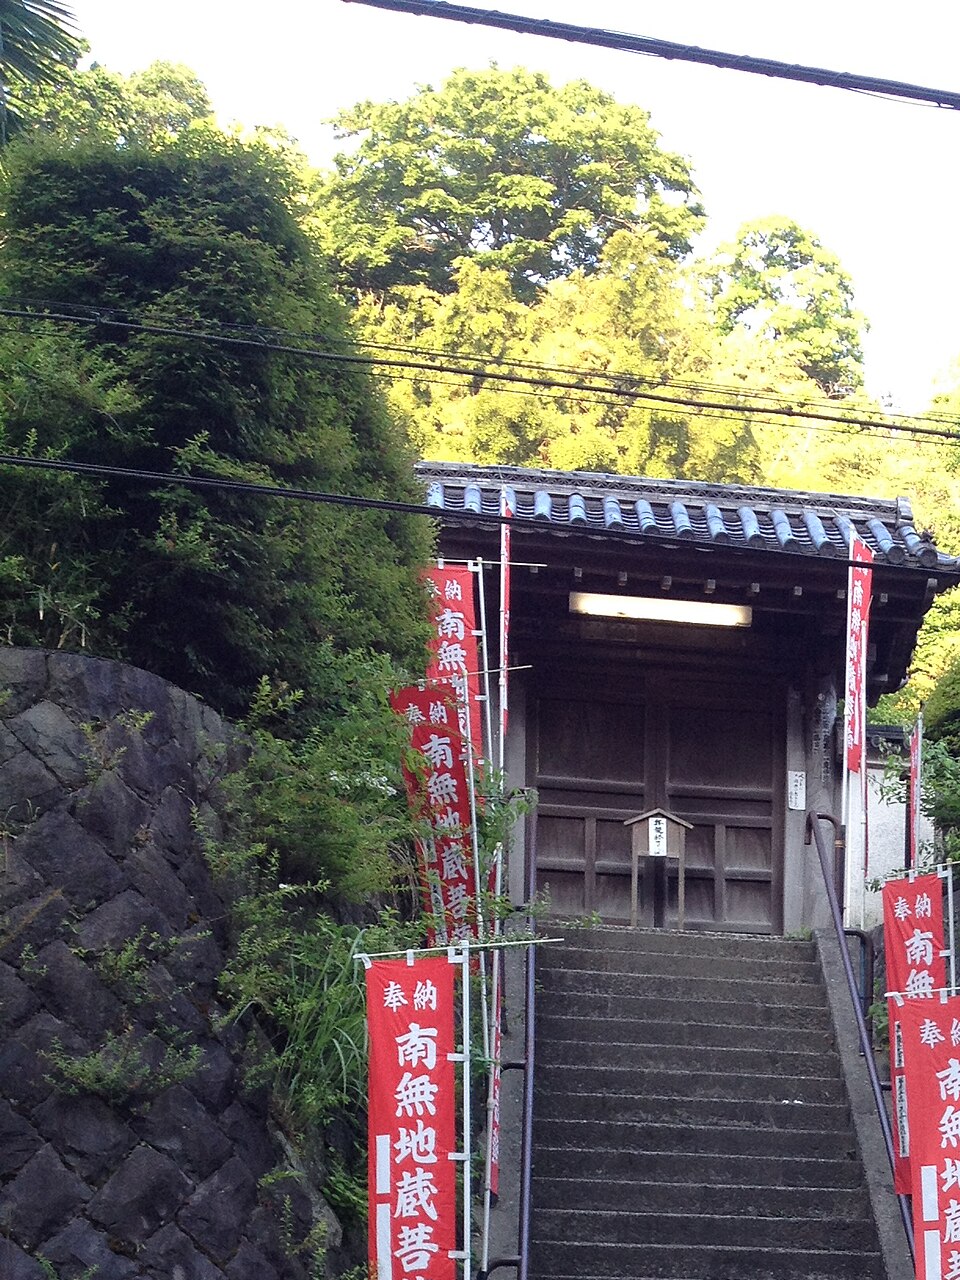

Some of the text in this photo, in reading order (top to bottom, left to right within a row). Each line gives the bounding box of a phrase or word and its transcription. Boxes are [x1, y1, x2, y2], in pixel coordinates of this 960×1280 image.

[405, 702, 448, 726] 奉納
[894, 892, 932, 921] 奉納
[382, 979, 438, 1011] 奉納
